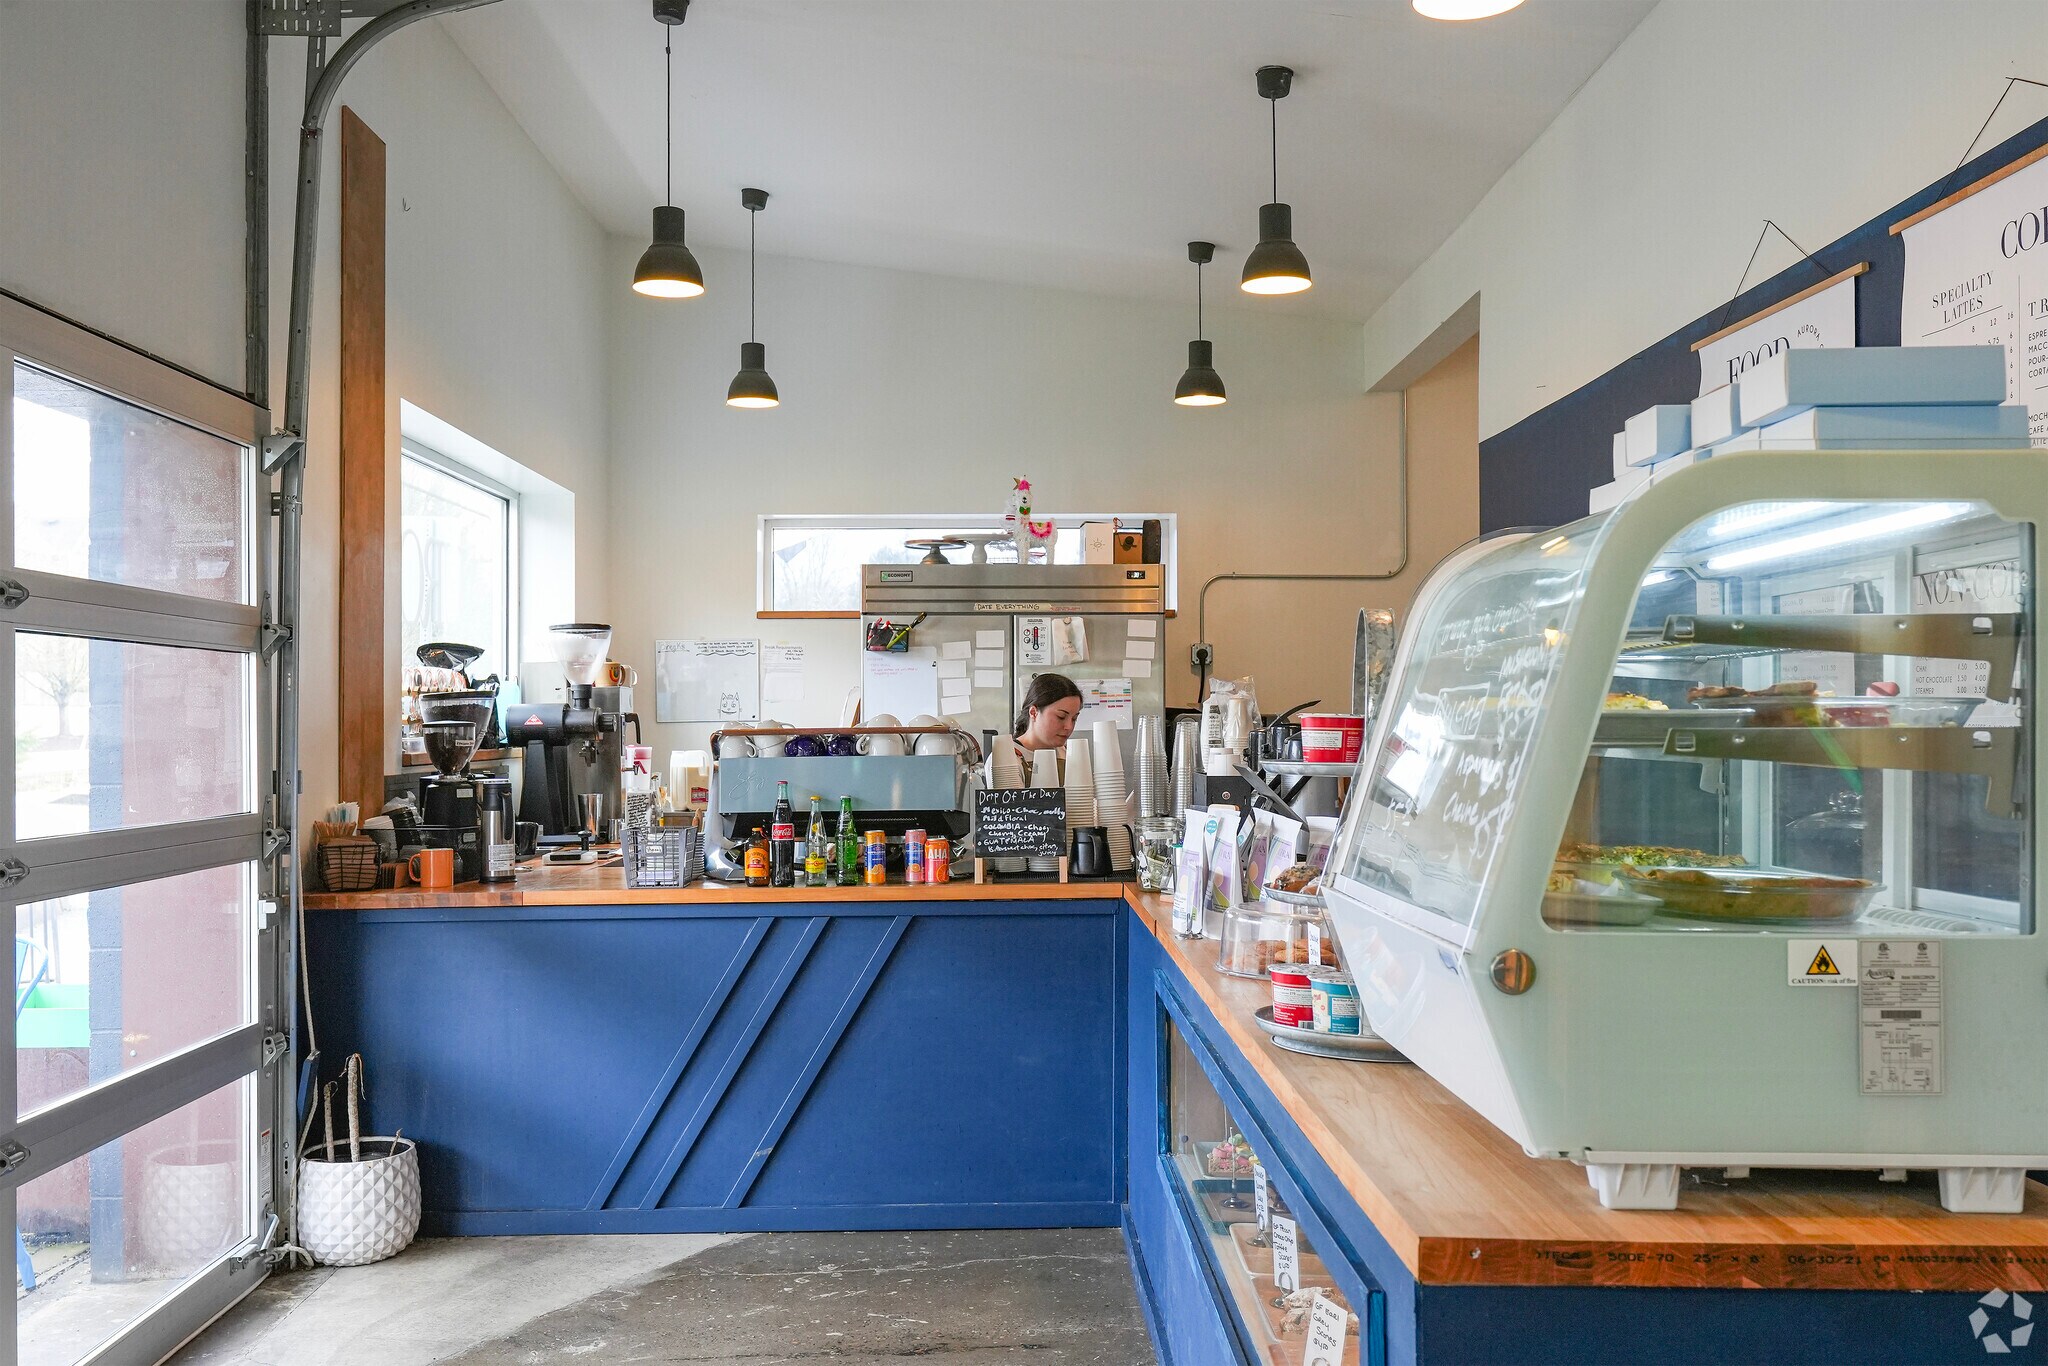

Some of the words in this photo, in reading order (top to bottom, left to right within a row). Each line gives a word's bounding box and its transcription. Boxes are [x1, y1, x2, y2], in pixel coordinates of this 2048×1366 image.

[1932, 270, 1994, 309] SPECIALTY
[1943, 295, 1983, 324] LATTES
[1990, 318, 1997, 326] 12
[1797, 324, 1821, 341] AURORA
[979, 790, 999, 806] Drip
[1002, 790, 1018, 804] Of
[1021, 789, 1037, 800] The
[1040, 788, 1058, 799] Day
[1005, 814, 1027, 822] Floral
[928, 848, 947, 860] AHA
[1787, 1255, 1862, 1265] 06/30/21
[1315, 1301, 1324, 1310] GF
[1316, 1325, 1337, 1348] Scones
